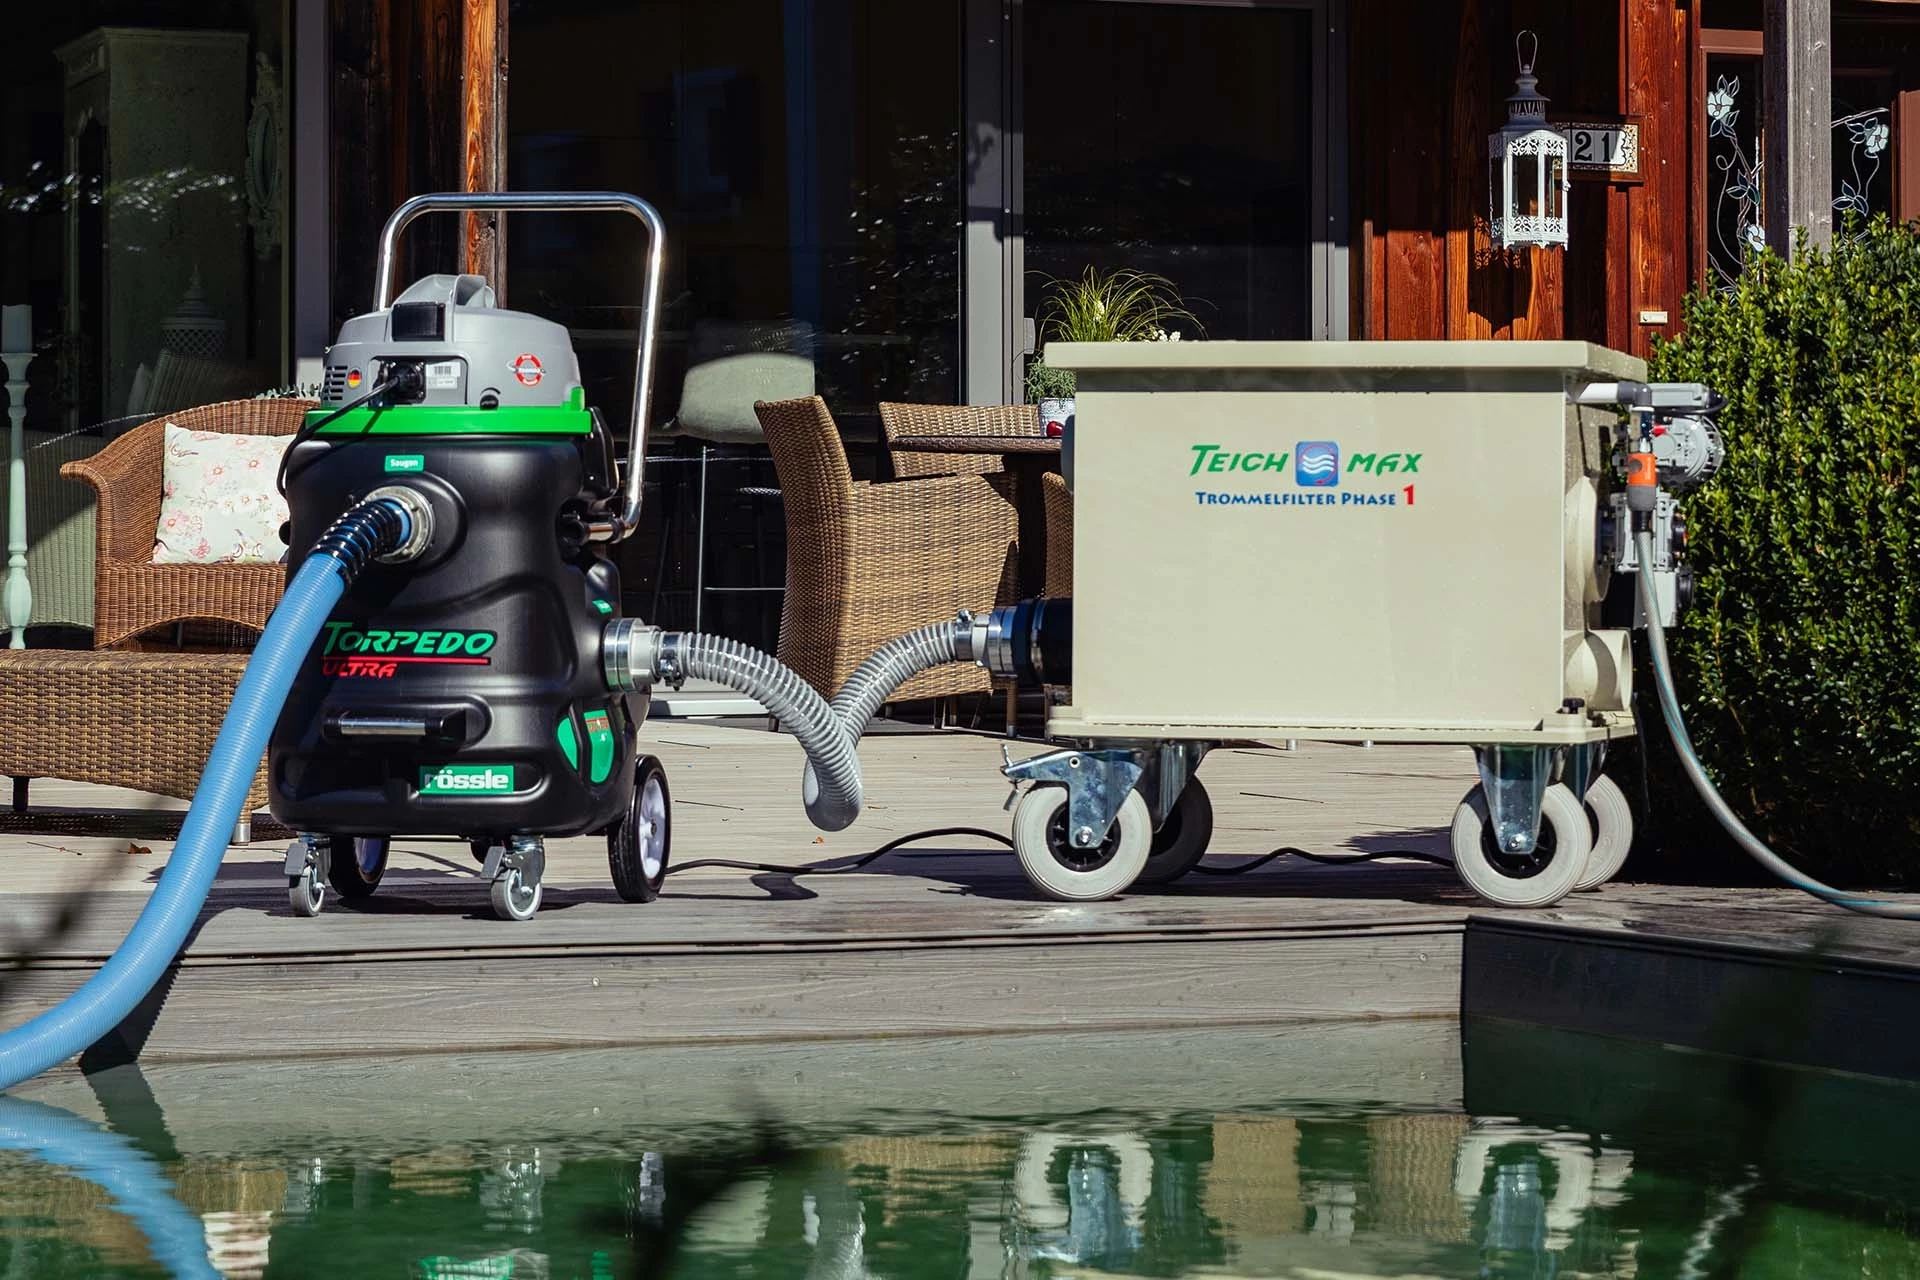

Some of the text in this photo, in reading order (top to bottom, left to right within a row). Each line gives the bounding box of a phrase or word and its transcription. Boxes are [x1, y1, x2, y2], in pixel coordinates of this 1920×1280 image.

[1574, 131, 1611, 163] 21
[1190, 444, 1423, 476] TEICH MAX
[1195, 484, 1415, 506] TROMMELFILTER PHASE 1
[323, 621, 495, 656] TORPEDO
[322, 662, 397, 679] ULTRA
[424, 769, 509, 789] rössle
